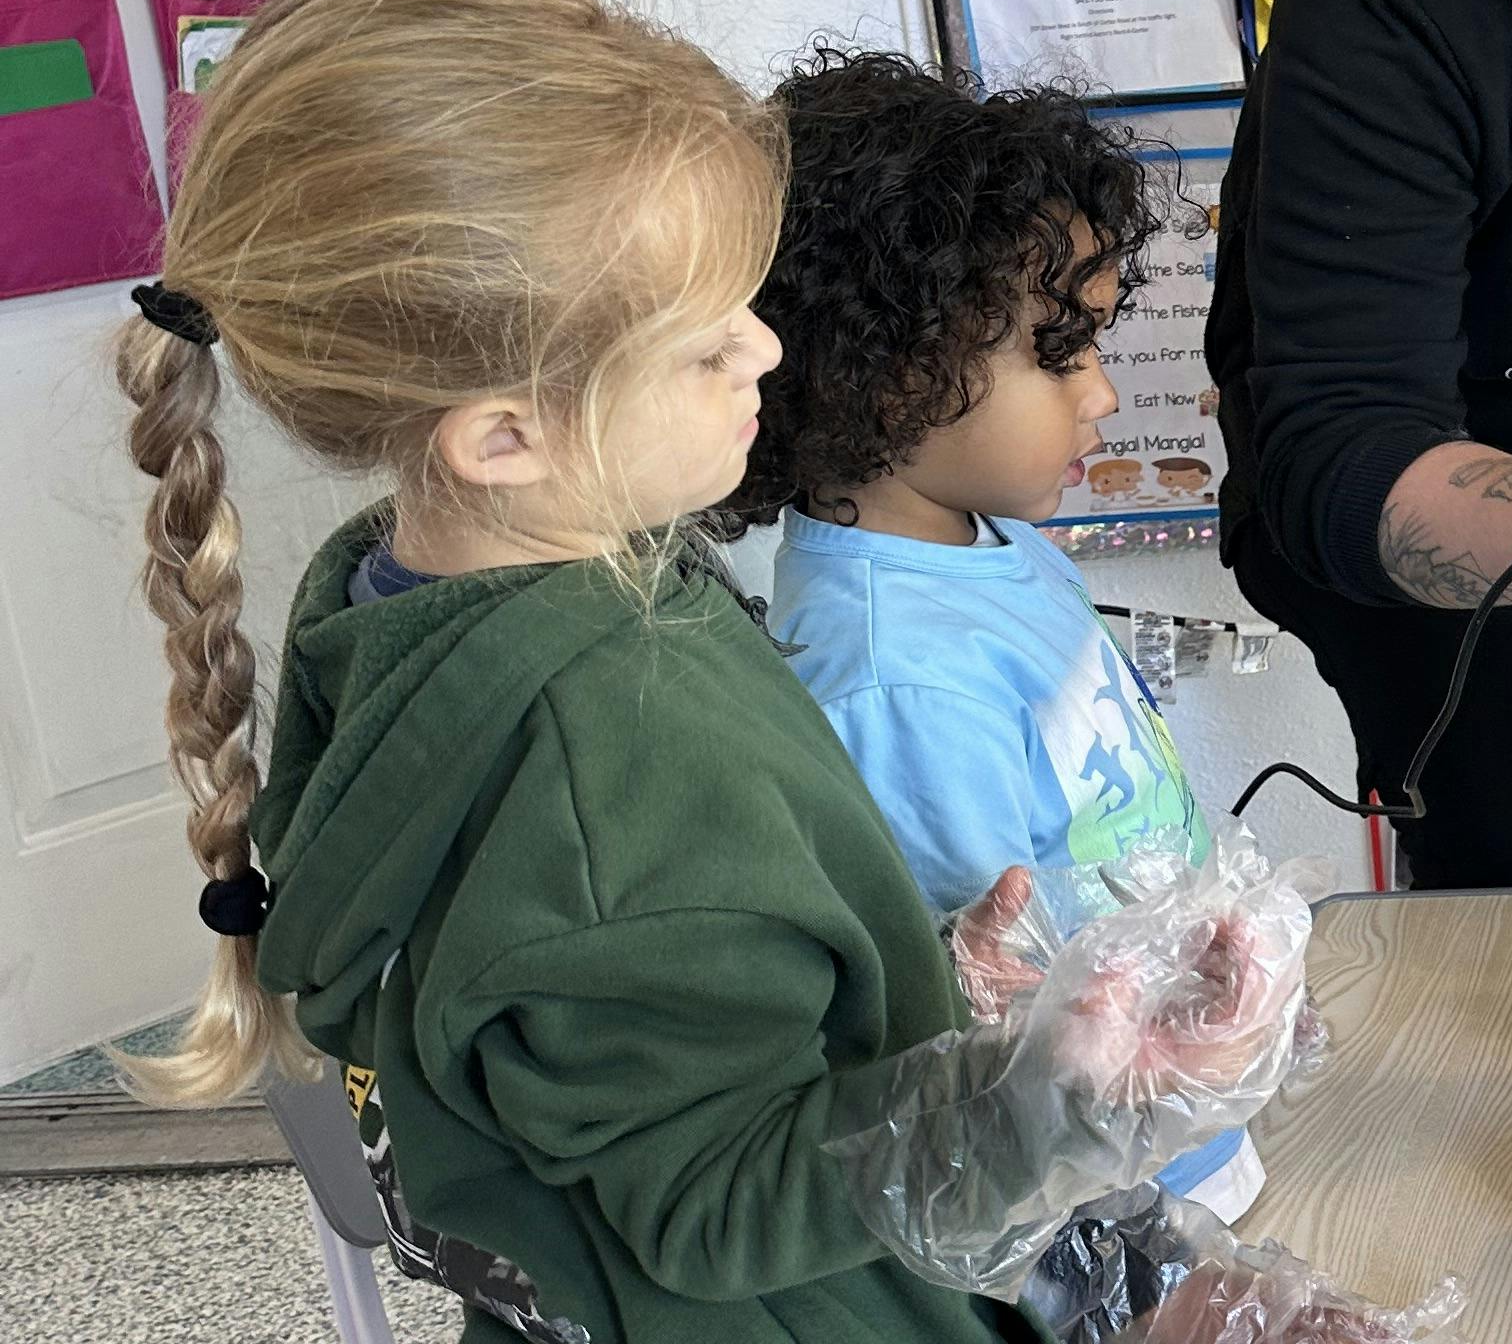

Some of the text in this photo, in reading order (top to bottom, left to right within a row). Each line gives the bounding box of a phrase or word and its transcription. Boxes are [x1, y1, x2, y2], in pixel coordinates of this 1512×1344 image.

[1128, 348, 1186, 366] you for
[1134, 393, 1196, 408] Eat Now
